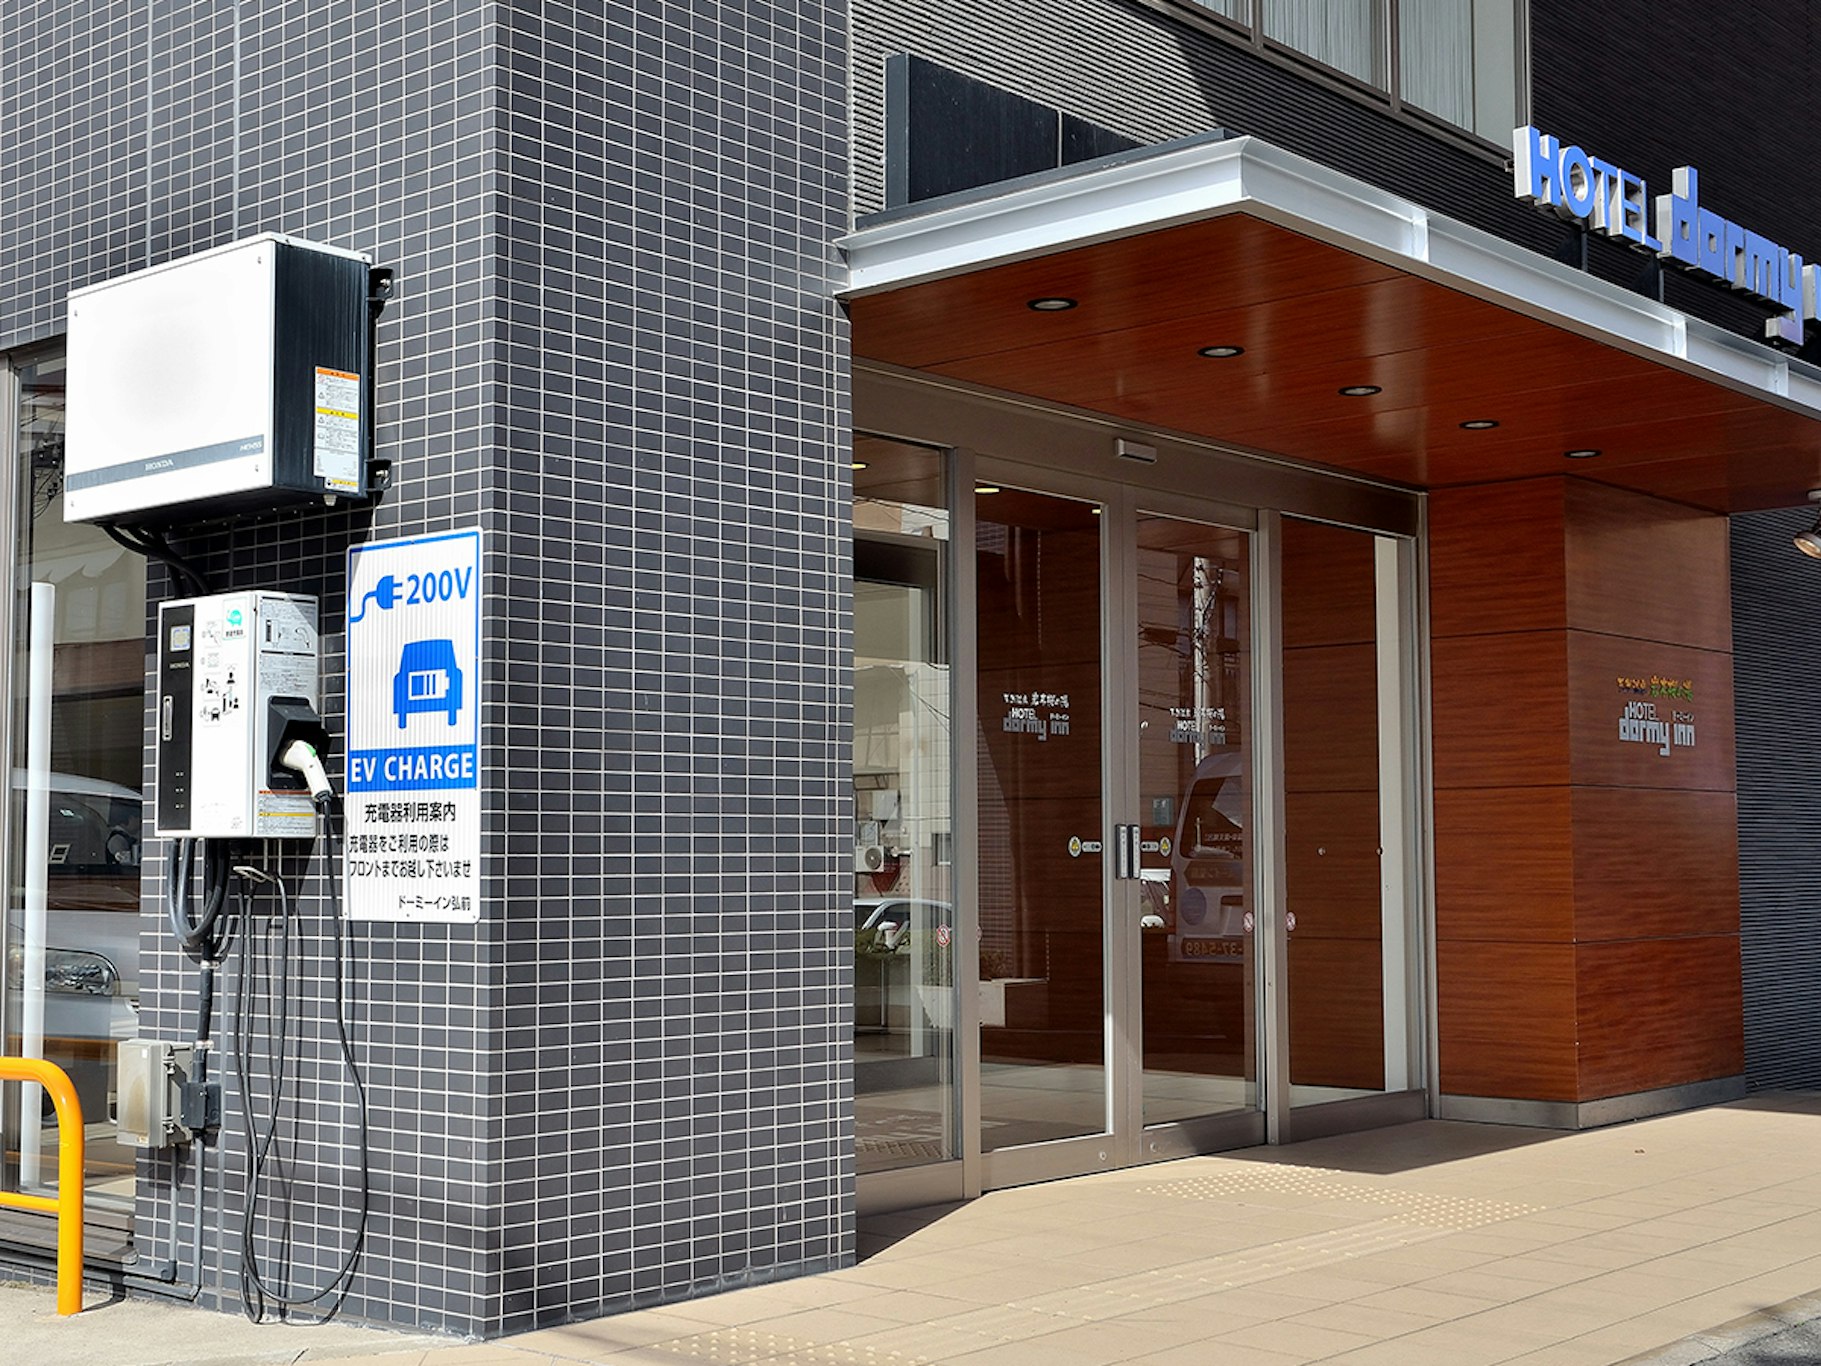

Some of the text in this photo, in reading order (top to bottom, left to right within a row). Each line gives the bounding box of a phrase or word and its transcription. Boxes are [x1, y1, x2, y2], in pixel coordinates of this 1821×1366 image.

[1513, 125, 1804, 346] HOTEL dormy
[406, 566, 473, 605] 200V
[1011, 707, 1038, 720] HOTEL
[1629, 701, 1659, 721] HOTEL
[1003, 711, 1069, 741] dormy inn
[1619, 706, 1695, 756] dormy inn
[351, 750, 473, 783] EV CHARGE
[365, 801, 456, 823] 充電器利用案内
[349, 833, 449, 853] 充電器をご利用の際は
[349, 859, 471, 878] フロントまでお越し下さいませ
[399, 895, 471, 911] ドーミーイン弘前
